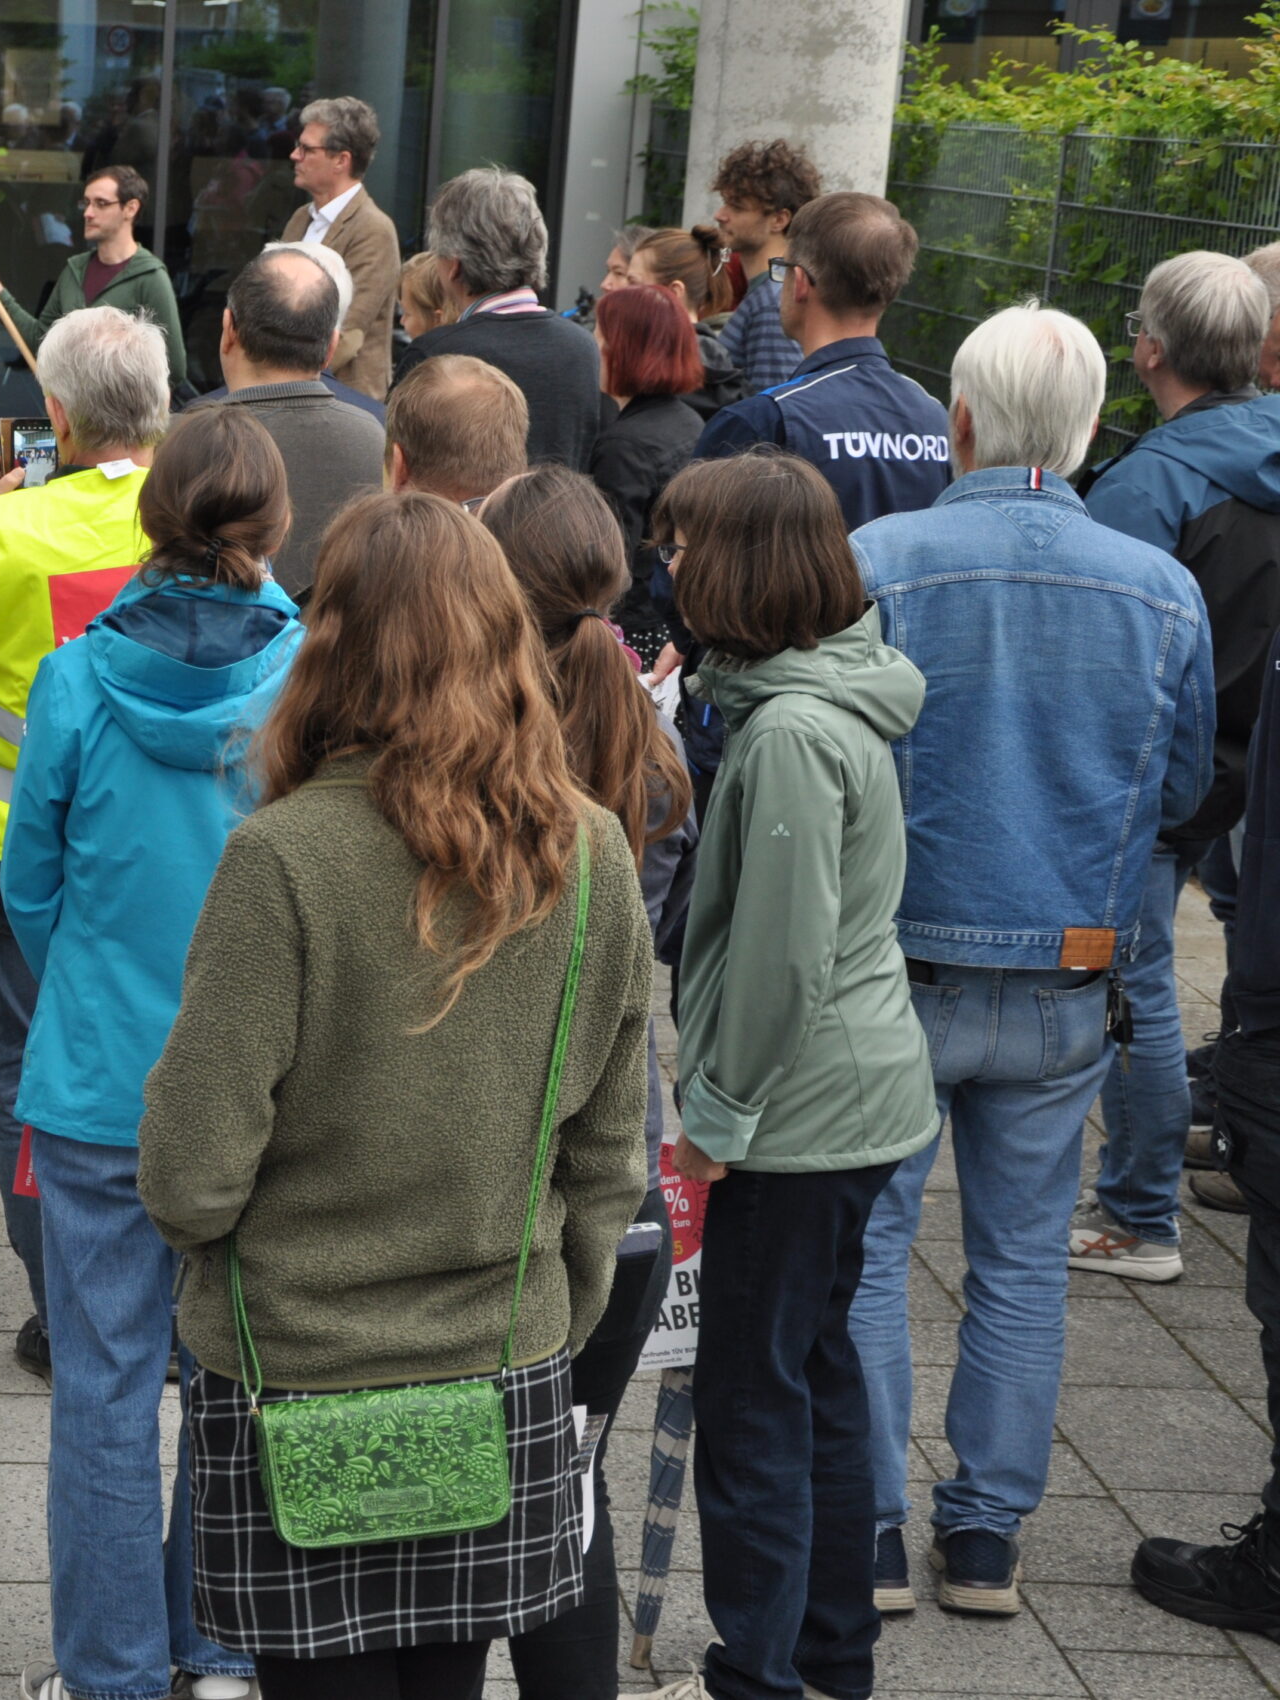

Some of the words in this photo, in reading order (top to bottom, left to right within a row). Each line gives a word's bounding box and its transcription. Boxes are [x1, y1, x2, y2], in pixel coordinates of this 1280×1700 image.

[822, 432, 949, 461] TÜVNORD
[660, 1175, 681, 1185] dern
[673, 1219, 691, 1229] Euro
[673, 1240, 684, 1255] 5
[654, 1302, 700, 1333] ABE
